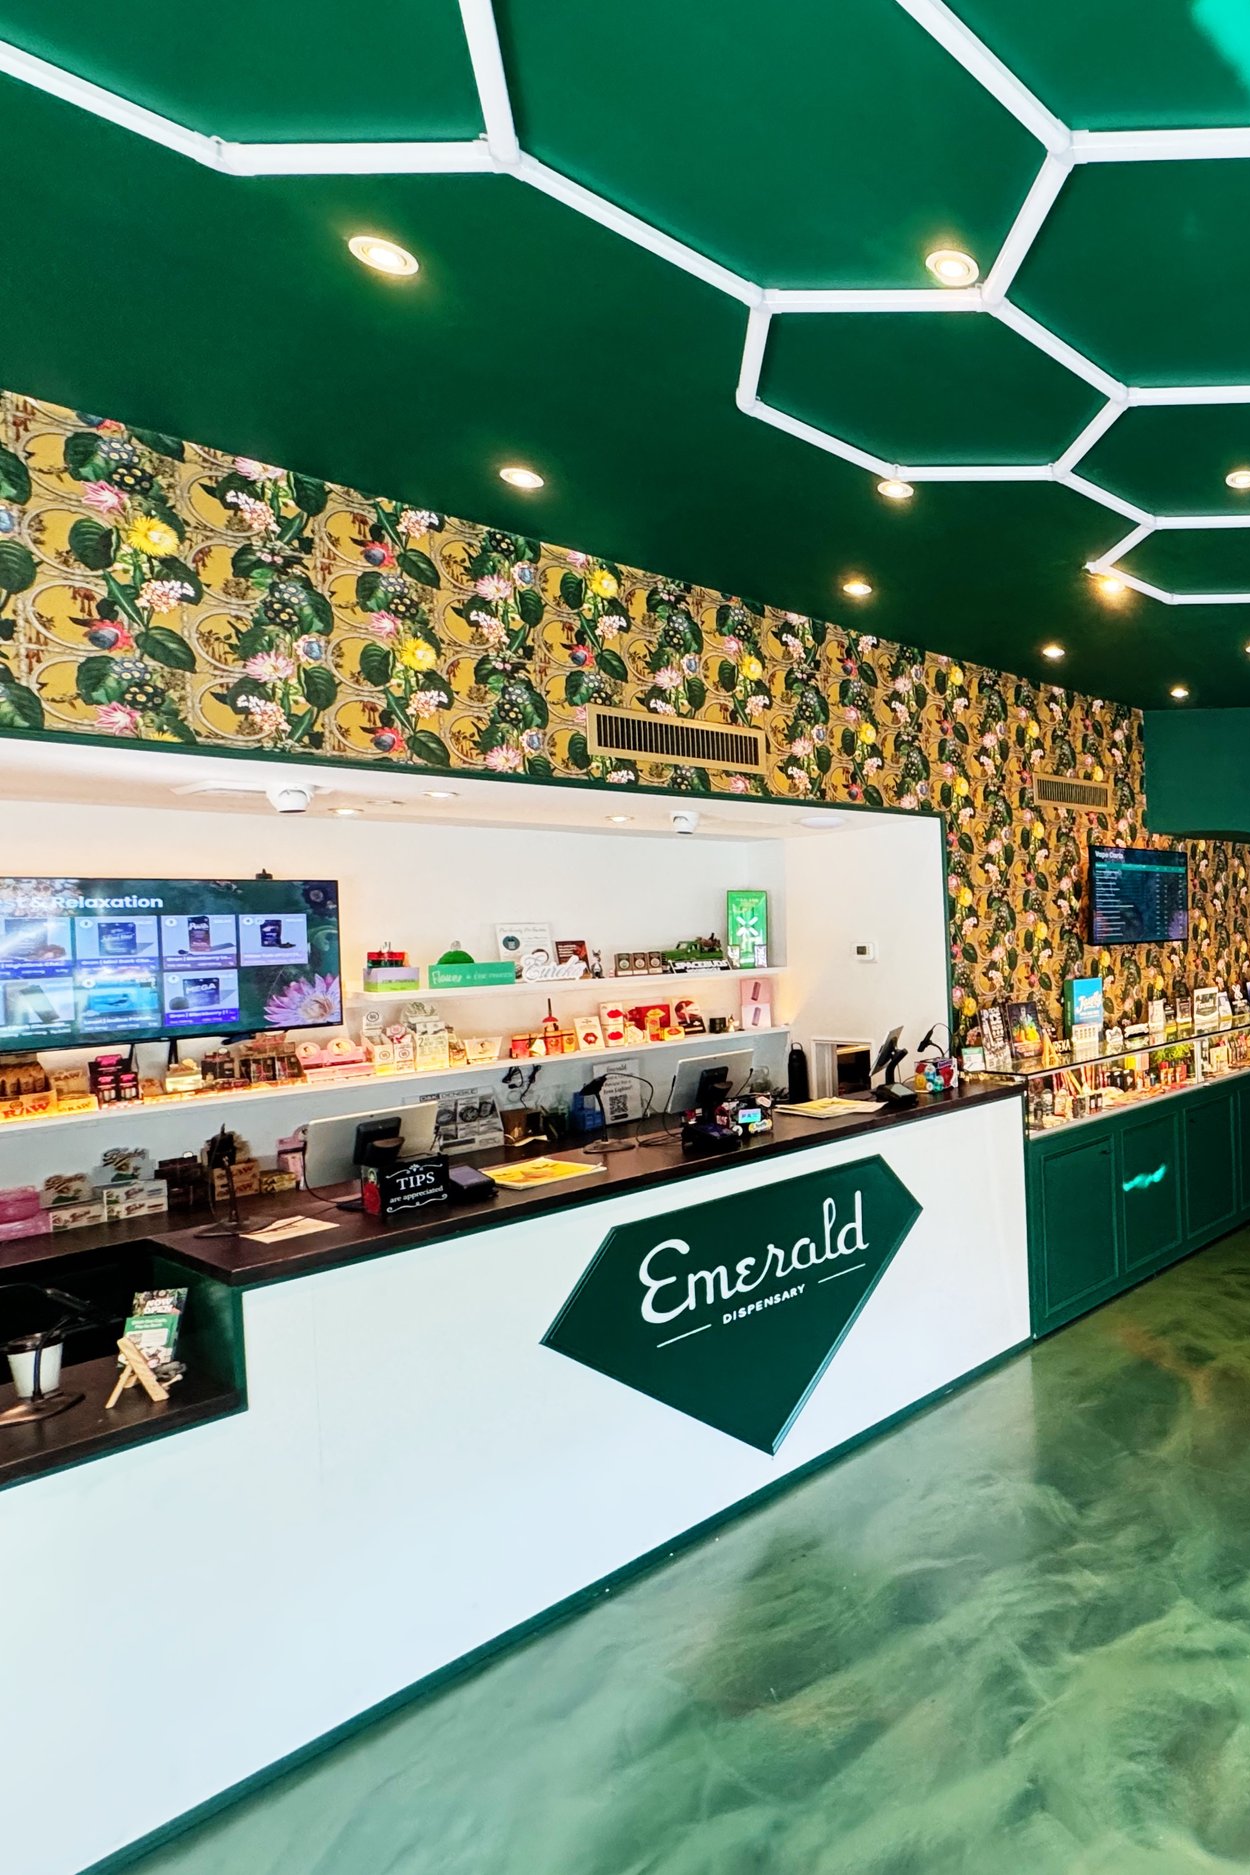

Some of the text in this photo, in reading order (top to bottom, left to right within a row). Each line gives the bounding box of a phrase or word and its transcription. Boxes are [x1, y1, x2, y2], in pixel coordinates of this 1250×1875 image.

[51, 895, 164, 908] Relaxation
[523, 956, 587, 980] Eureka
[185, 983, 215, 994] MEGA
[2, 1101, 51, 1119] RAW
[396, 1172, 435, 1190] TIPS
[402, 1185, 444, 1201] appreciated
[639, 1191, 870, 1324] Emerald
[722, 1283, 806, 1325] DISPENSARY
